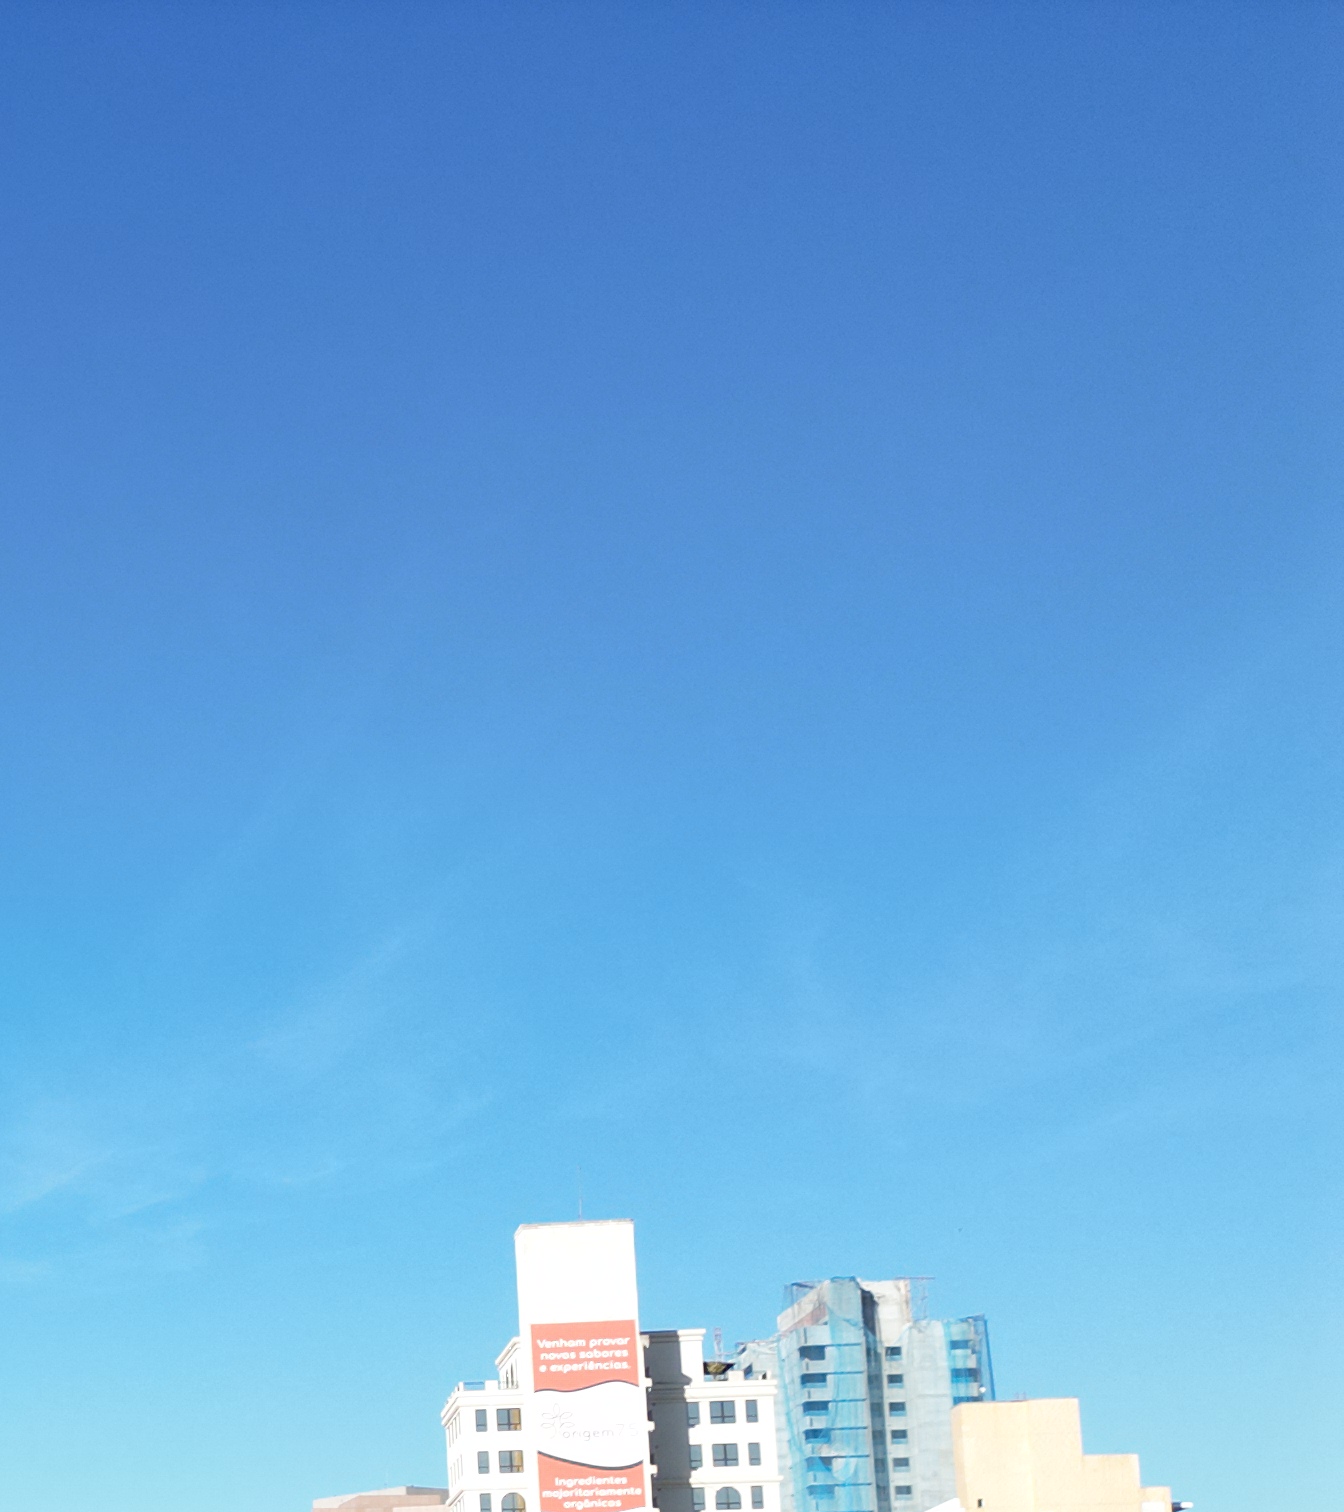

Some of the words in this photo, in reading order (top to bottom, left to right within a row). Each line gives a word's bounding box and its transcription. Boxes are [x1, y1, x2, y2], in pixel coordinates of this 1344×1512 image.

[537, 1338, 586, 1349] Venham
[588, 1337, 631, 1348] provar
[540, 1351, 577, 1360] novas
[579, 1349, 629, 1359] sabores
[539, 1365, 547, 1373] e
[554, 1476, 628, 1488] Ingredientes
[542, 1487, 643, 1499] majoritariamente
